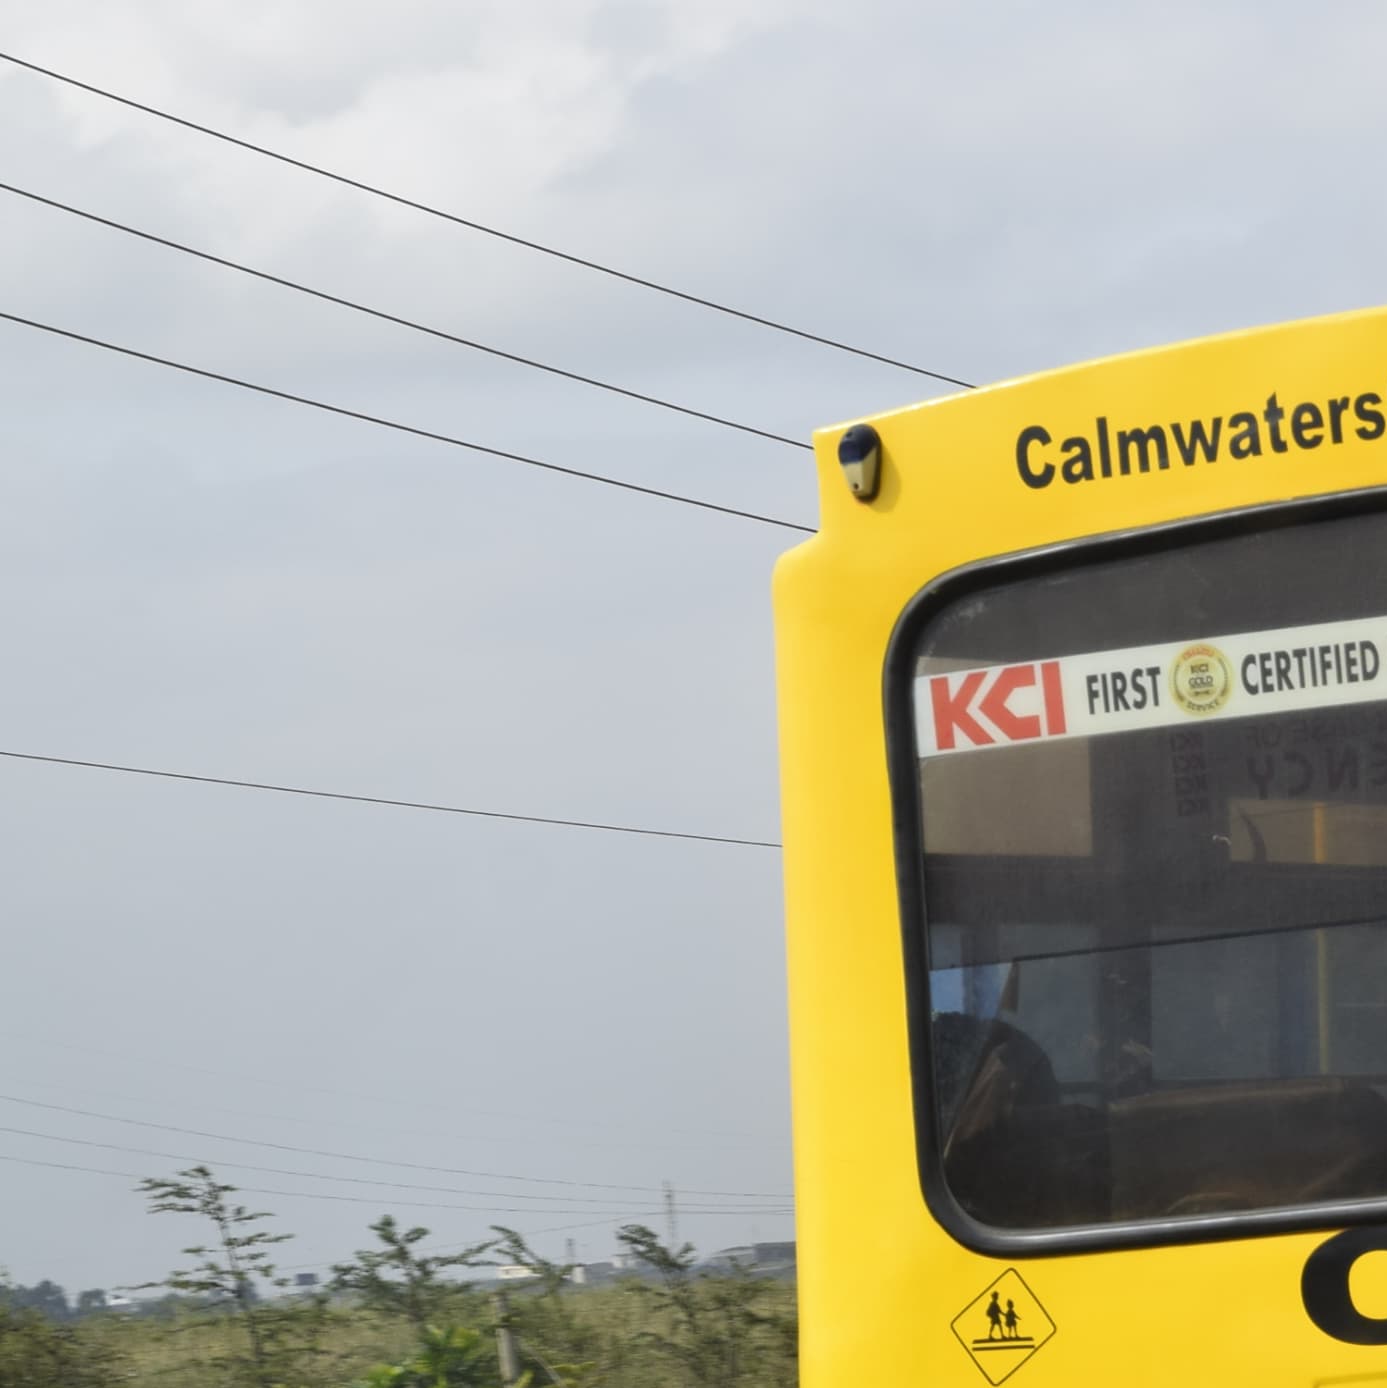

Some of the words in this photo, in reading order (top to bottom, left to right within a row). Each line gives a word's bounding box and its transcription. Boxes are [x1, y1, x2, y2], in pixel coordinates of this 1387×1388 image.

[931, 662, 1067, 749] KCI
[1085, 666, 1161, 715] FIRST
[1240, 640, 1381, 696] CERTIFIED
